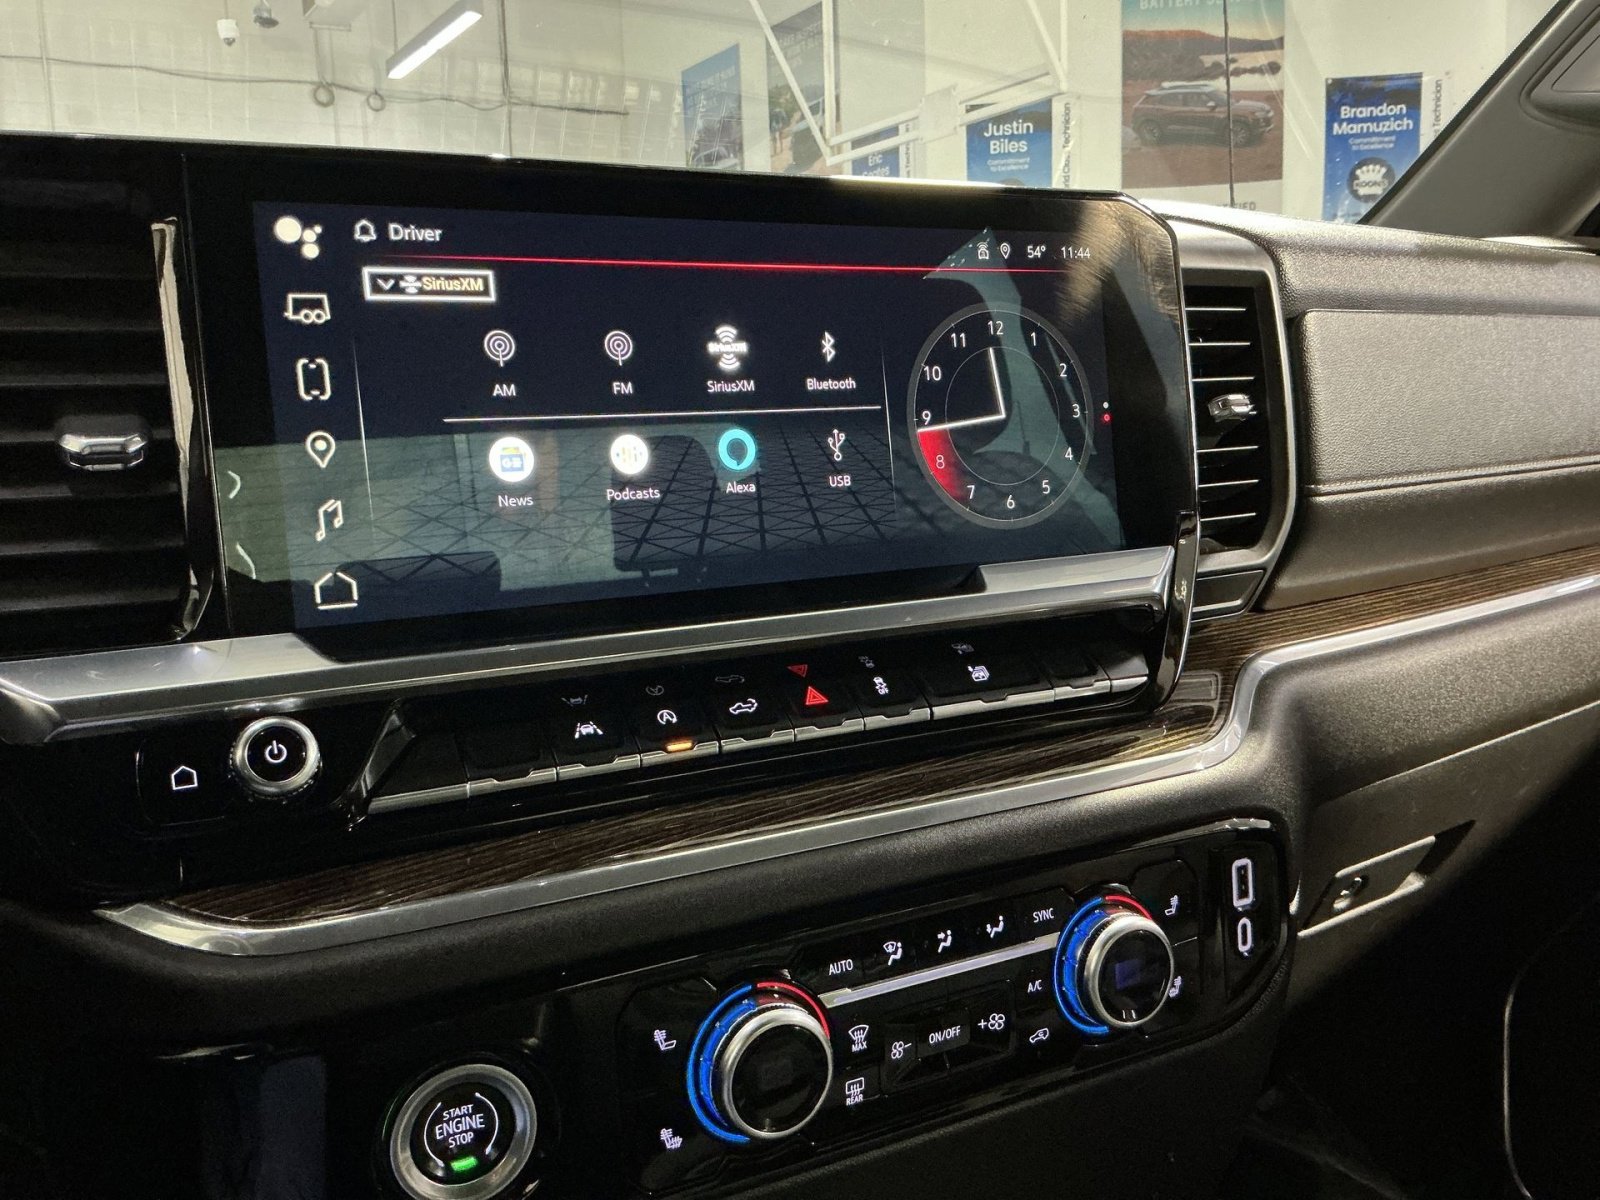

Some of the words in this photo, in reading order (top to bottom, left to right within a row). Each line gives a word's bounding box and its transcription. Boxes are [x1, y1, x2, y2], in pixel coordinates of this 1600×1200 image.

[1340, 103, 1407, 119] Brandon
[1432, 79, 1442, 127] Technician
[983, 119, 1034, 137] Justin
[1062, 102, 1071, 149] Technician
[1332, 117, 1414, 136] Mamuzich
[989, 138, 1029, 155] Biles
[388, 222, 443, 242] Driver
[1060, 246, 1091, 259] 11:44
[421, 276, 484, 293] SiriusXM
[987, 320, 1004, 336] 12
[950, 332, 966, 348] 11
[1030, 331, 1037, 347] 1
[923, 365, 942, 382] 10
[1059, 362, 1068, 378] 2
[492, 383, 517, 397] AM
[612, 381, 633, 395] FM
[706, 379, 755, 393] SiriusXM
[806, 376, 857, 391] Bluetooth
[921, 410, 932, 425] 9
[1072, 403, 1081, 418] 3
[1064, 446, 1074, 461] 4
[935, 454, 945, 470] 8
[725, 480, 756, 494] Alexa
[828, 474, 852, 488] USB
[1042, 479, 1051, 495] 5
[605, 487, 661, 501] Podcasts
[966, 484, 975, 500] 7
[497, 494, 534, 508] News
[1006, 494, 1016, 510] 6
[1032, 907, 1055, 923] SYNC
[828, 958, 854, 976] AUTO
[1027, 979, 1043, 993] A/C
[928, 1025, 961, 1044] ON/OFF
[851, 1041, 868, 1052] MAX
[845, 1093, 864, 1106] REAR
[442, 1103, 474, 1121] START
[435, 1113, 486, 1140] ENGINE
[448, 1131, 474, 1148] STOP
